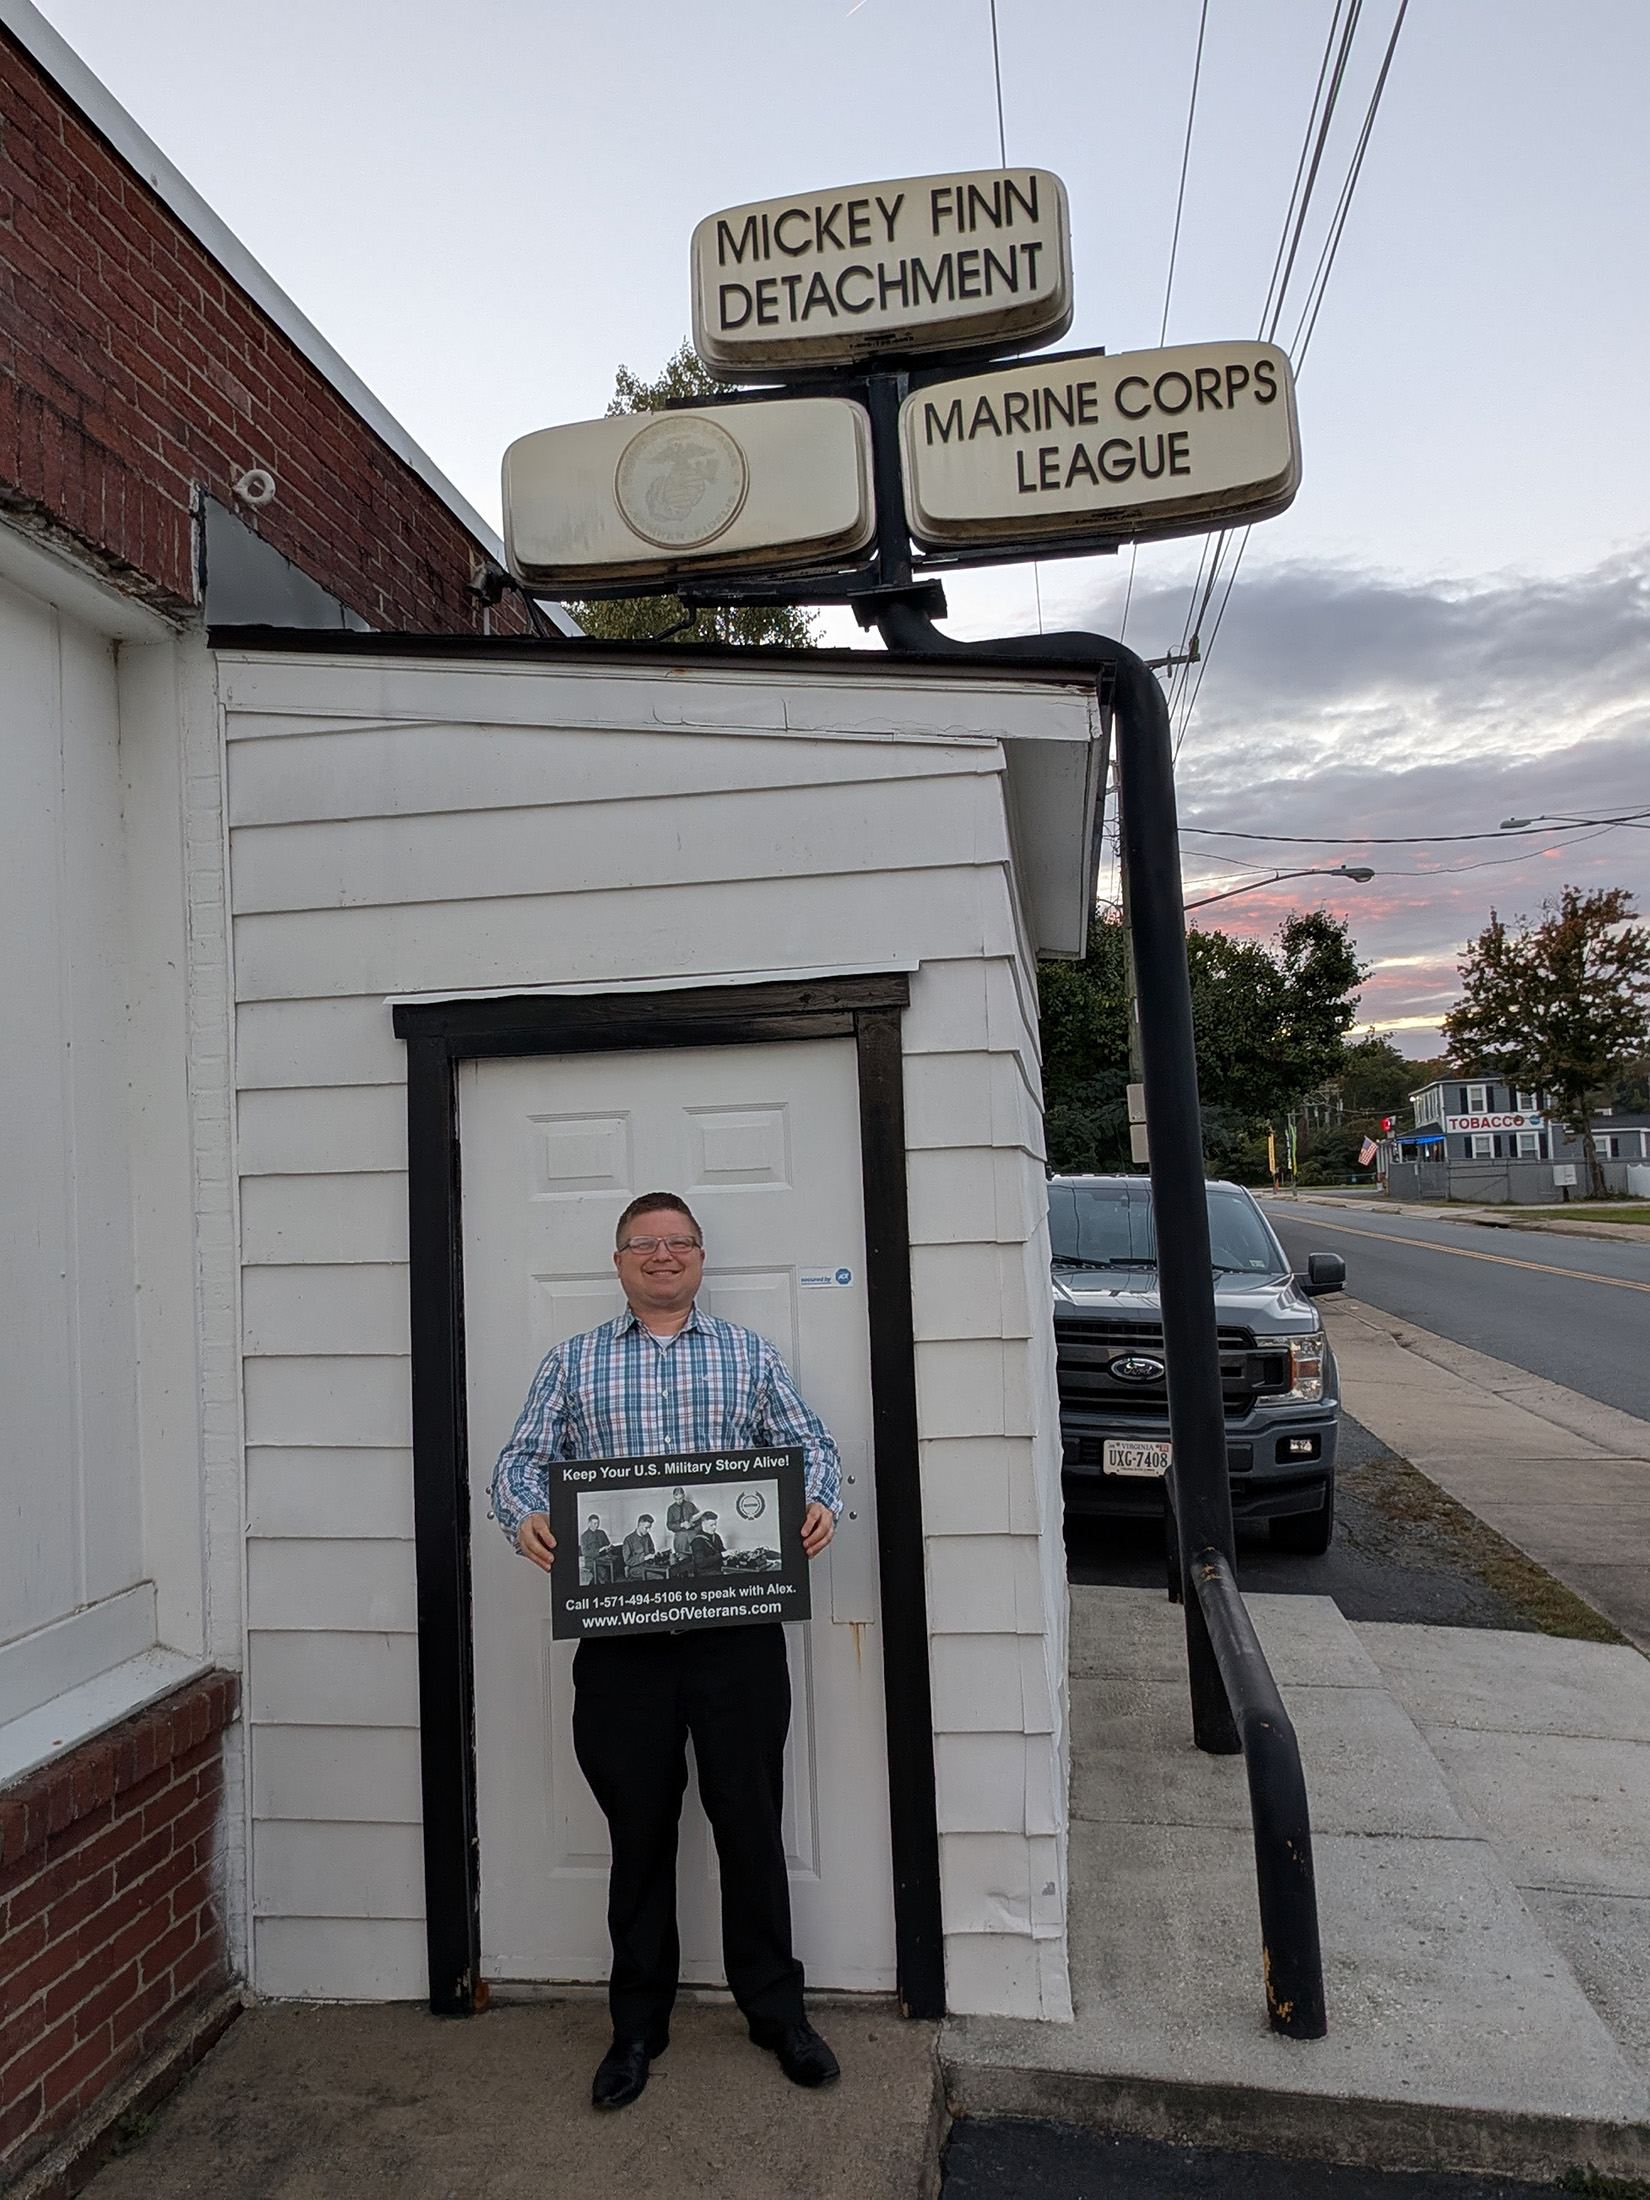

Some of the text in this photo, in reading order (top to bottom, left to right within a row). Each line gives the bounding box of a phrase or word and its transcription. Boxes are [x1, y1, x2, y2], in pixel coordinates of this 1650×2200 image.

[716, 175, 1040, 266] MICKEY FINN
[719, 241, 1043, 331] DETACHMENT
[924, 359, 1278, 446] MARINE CORPS
[1016, 431, 1191, 494] LEAGUE
[1449, 1114, 1525, 1130] TOBACCO
[1121, 1443, 1154, 1451] VIRGINIA
[562, 1454, 790, 1482] Keep Your U.S. Military Story Alive!
[565, 1583, 797, 1611] Call 1-571-494-5106 to speak with Alex.
[582, 1602, 782, 1629] www.WordsOfVeterans.com
